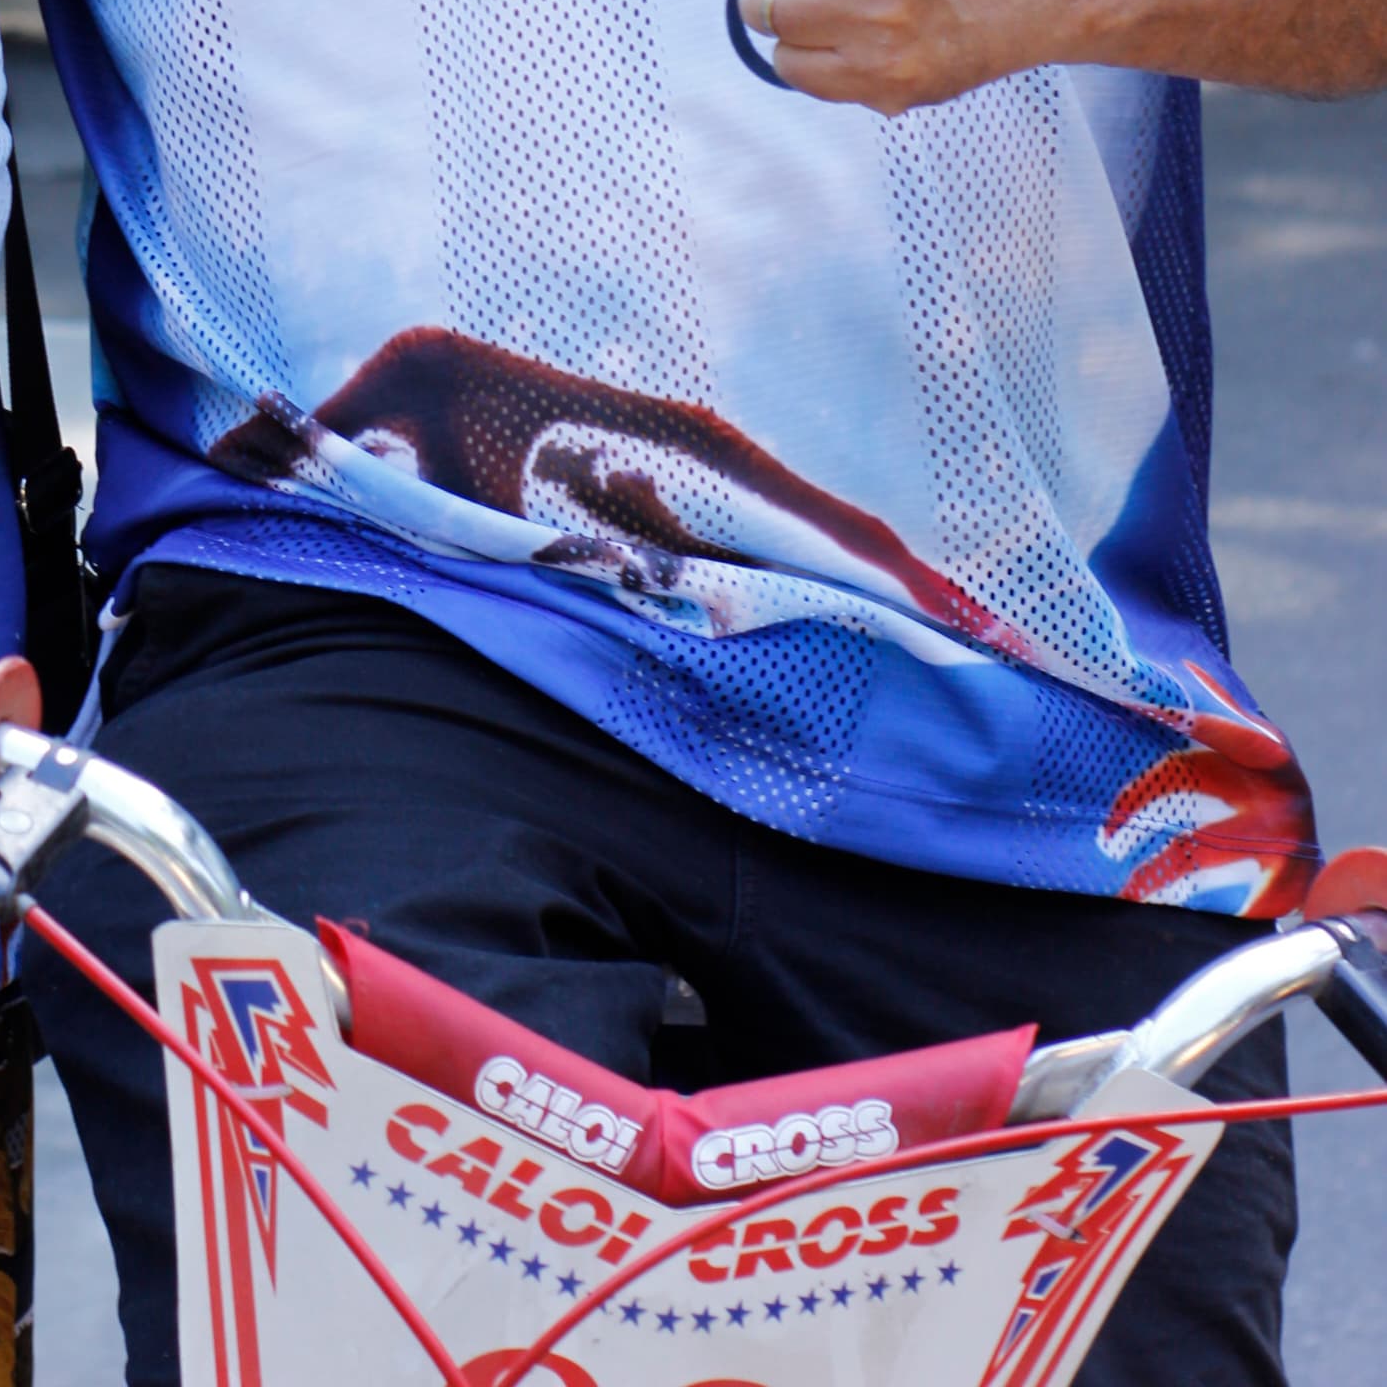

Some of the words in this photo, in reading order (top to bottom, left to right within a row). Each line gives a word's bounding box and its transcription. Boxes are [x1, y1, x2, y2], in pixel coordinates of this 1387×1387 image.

[385, 1103, 652, 1266] CALOI
[688, 1187, 960, 1284] CROSS
[475, 1056, 643, 1175] CALOI
[692, 1099, 900, 1190] CROSS
